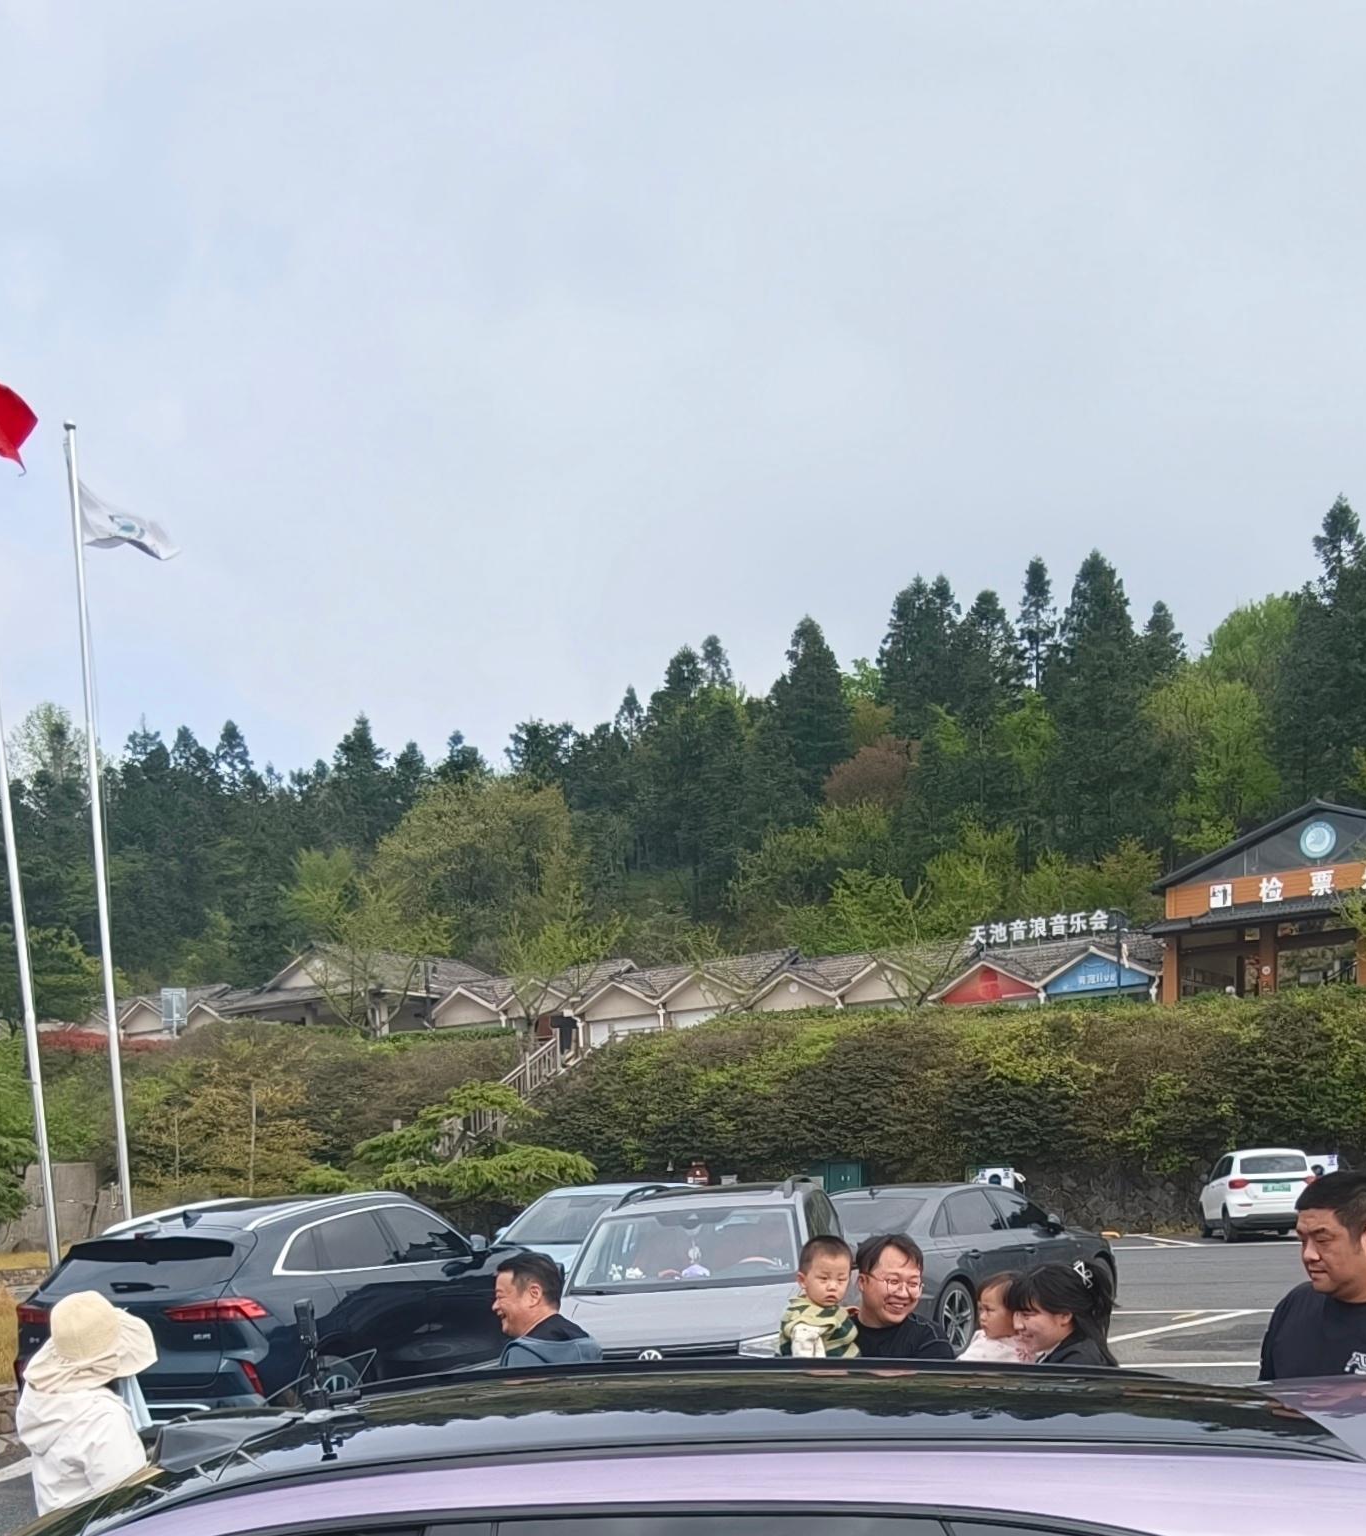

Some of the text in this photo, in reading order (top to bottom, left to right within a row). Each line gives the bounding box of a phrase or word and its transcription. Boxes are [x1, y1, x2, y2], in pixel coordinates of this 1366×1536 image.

[969, 909, 1109, 945] 天池音浪音乐会
